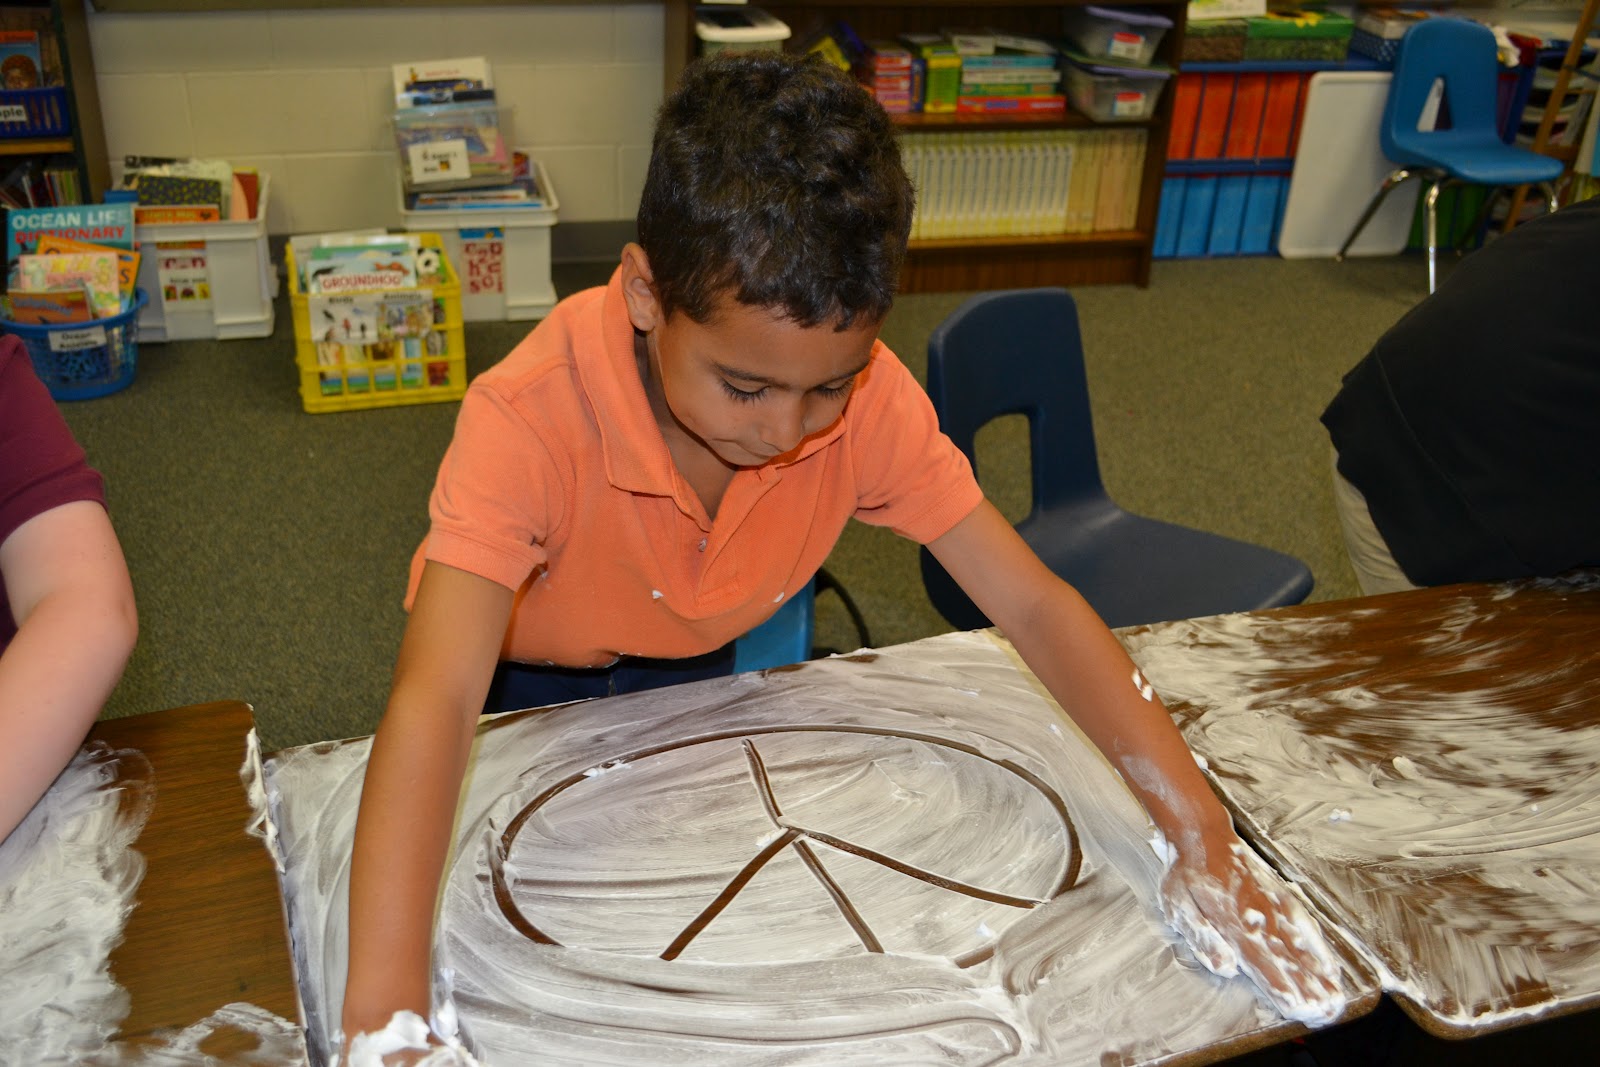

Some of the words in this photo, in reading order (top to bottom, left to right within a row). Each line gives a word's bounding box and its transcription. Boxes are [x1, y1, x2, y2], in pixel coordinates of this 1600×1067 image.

[12, 212, 81, 230] OCEAN
[87, 209, 131, 226] LIFE
[322, 273, 401, 289] GROUNDHOG
